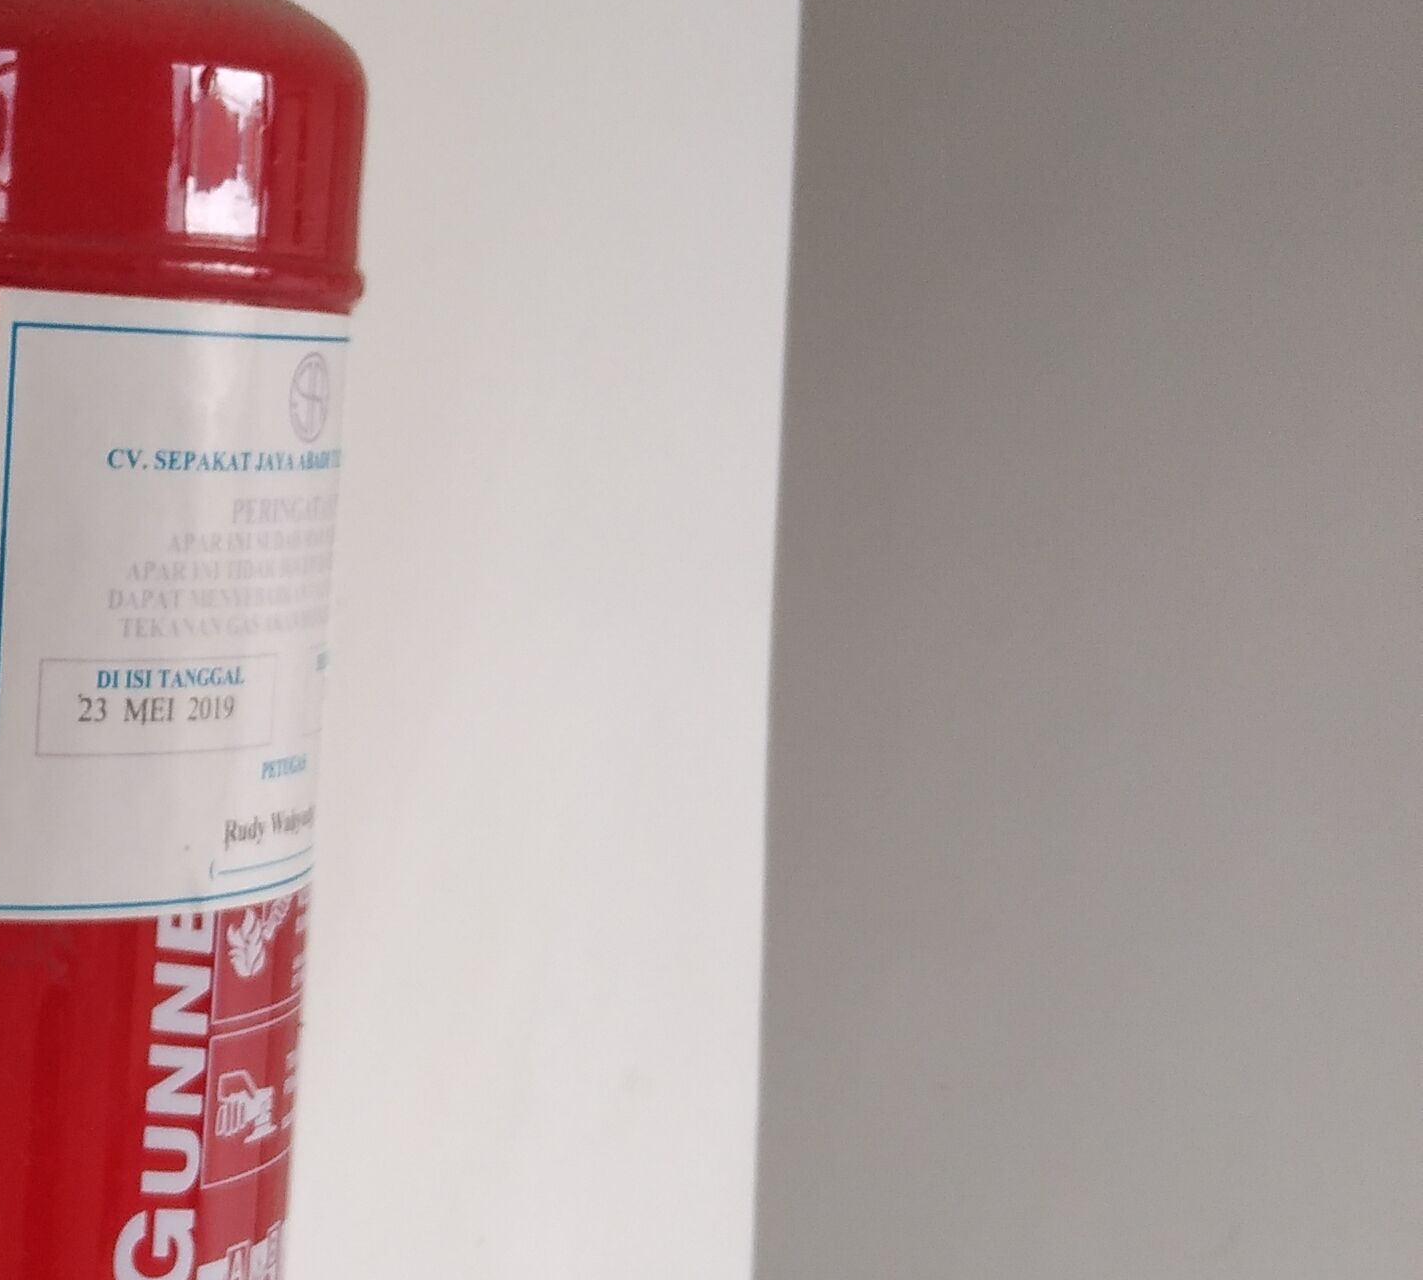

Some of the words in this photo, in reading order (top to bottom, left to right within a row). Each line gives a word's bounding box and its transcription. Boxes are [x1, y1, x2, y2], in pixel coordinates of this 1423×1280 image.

[107, 448, 147, 471] CV.
[153, 449, 253, 472] SEPAKAT
[255, 450, 294, 472] JAYA
[107, 588, 183, 610] DAPAT
[96, 669, 119, 689] DI
[125, 668, 152, 688] ISI
[158, 665, 245, 688] TANGGAL
[78, 695, 108, 723] 23
[123, 696, 175, 725] MEI
[186, 695, 235, 722] 2019
[224, 815, 264, 852] Rudy
